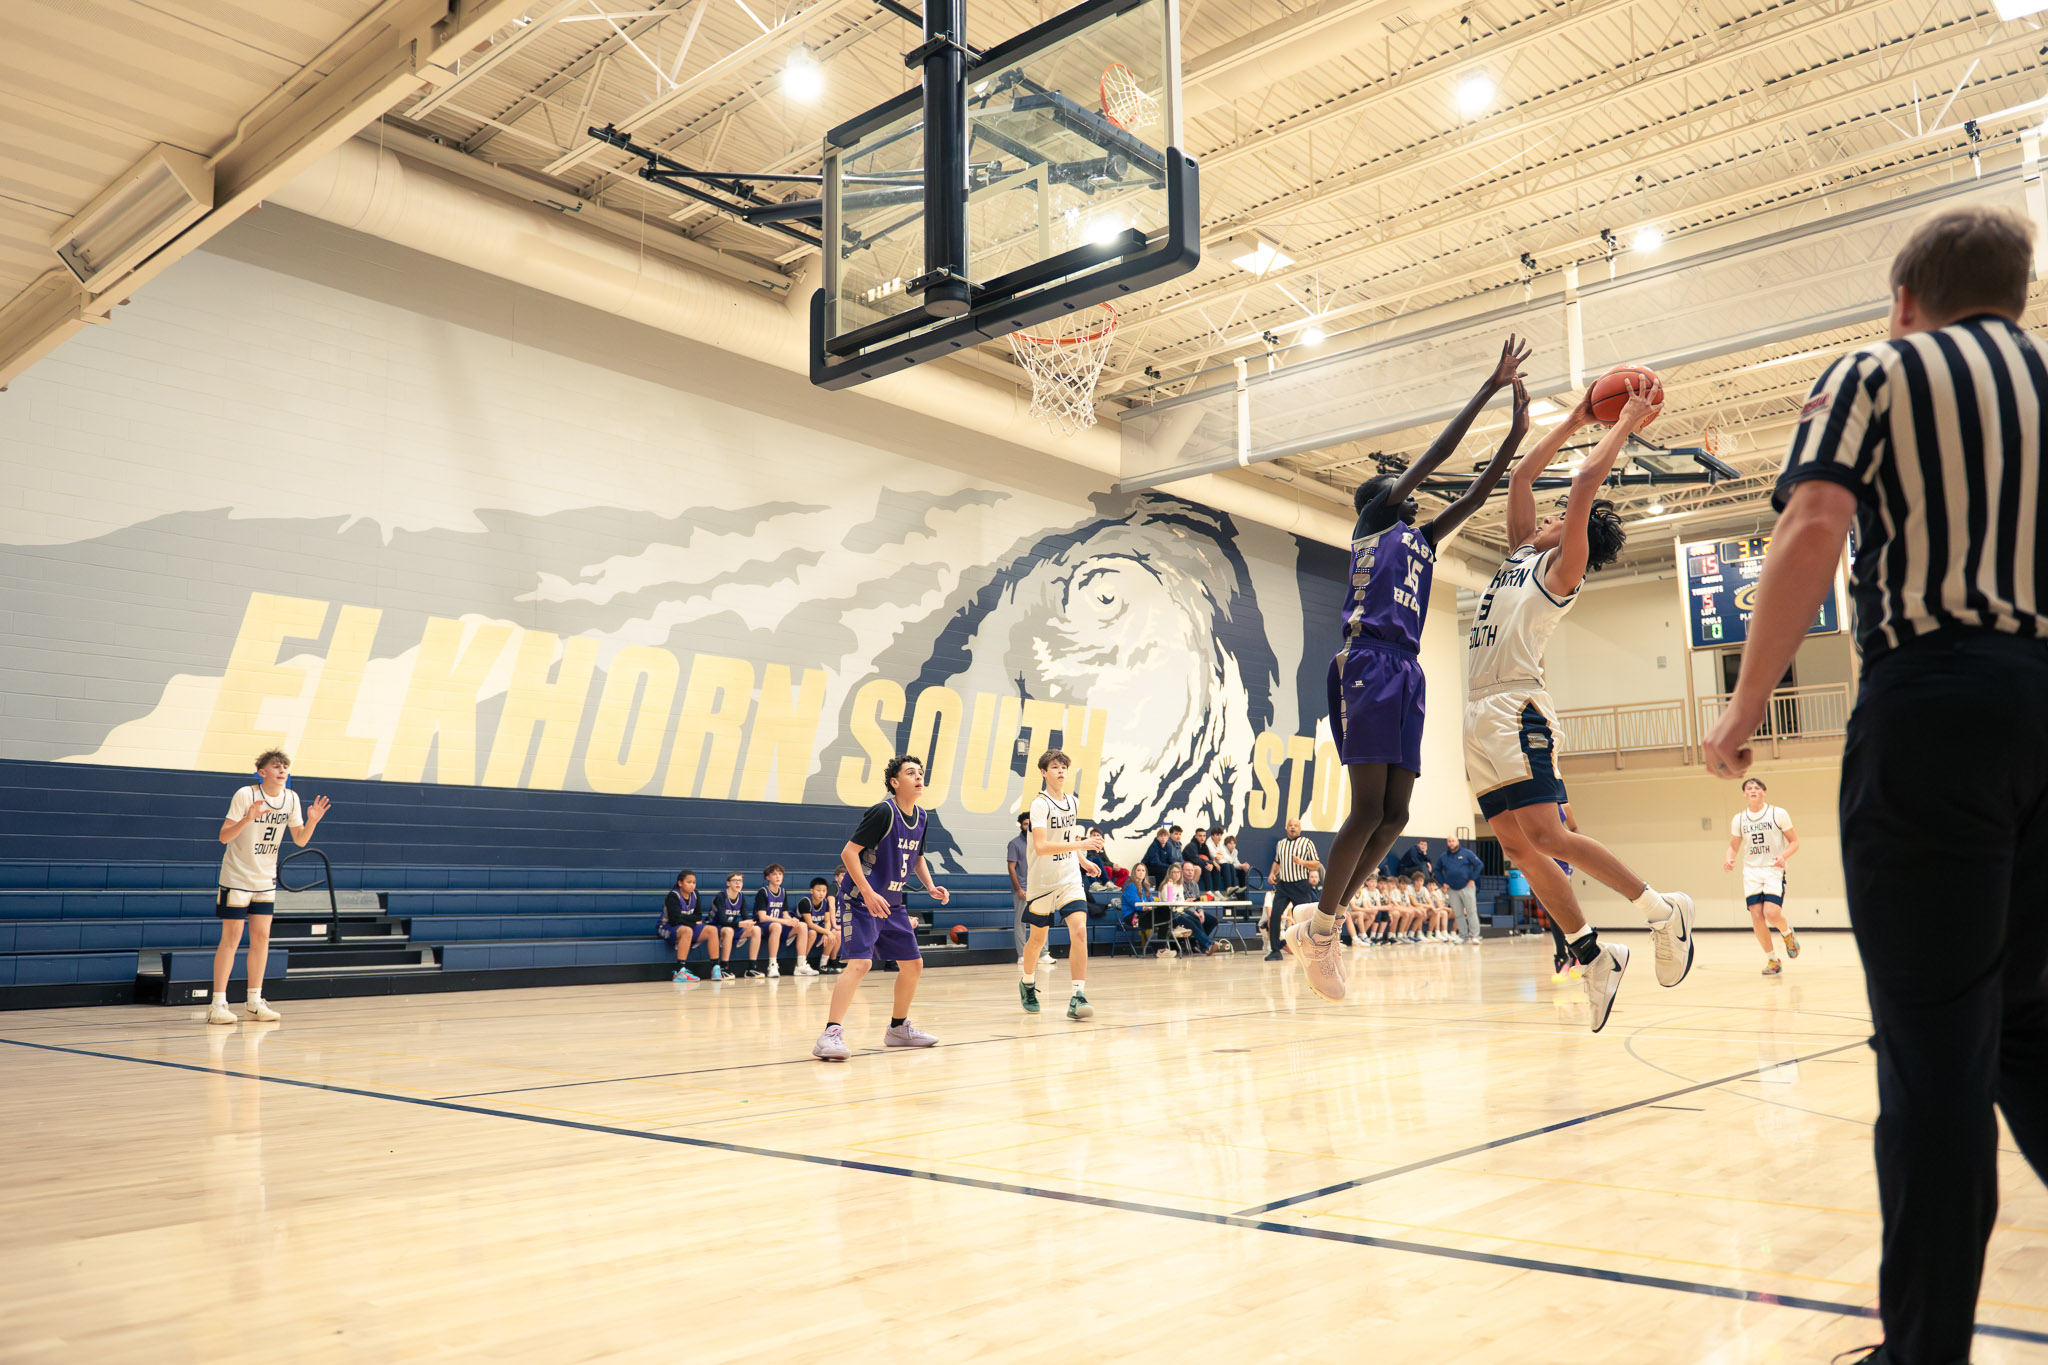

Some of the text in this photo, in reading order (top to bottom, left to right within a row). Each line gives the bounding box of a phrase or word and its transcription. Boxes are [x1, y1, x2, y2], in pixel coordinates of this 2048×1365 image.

[1737, 537, 1771, 559] 3:2
[1702, 556, 1719, 575] 15
[1404, 554, 1424, 595] 15
[1490, 568, 1531, 588] HORN
[1703, 594, 1713, 608] 5
[1701, 607, 1716, 616] LEFT
[1701, 616, 1722, 625] FOULS
[1712, 623, 1723, 639] 0
[193, 591, 1352, 832] ELKHORN SOUTH STO
[1050, 814, 1075, 829] ELKHO
[1743, 822, 1772, 833] ELKHORN
[263, 826, 277, 841] 21
[1063, 830, 1071, 843] 4
[1751, 833, 1764, 844] 23
[254, 843, 278, 854] SOUTH
[897, 837, 920, 851] EAST
[1749, 845, 1770, 855] SOUTH
[900, 853, 910, 878] 5
[887, 880, 907, 892] HI
